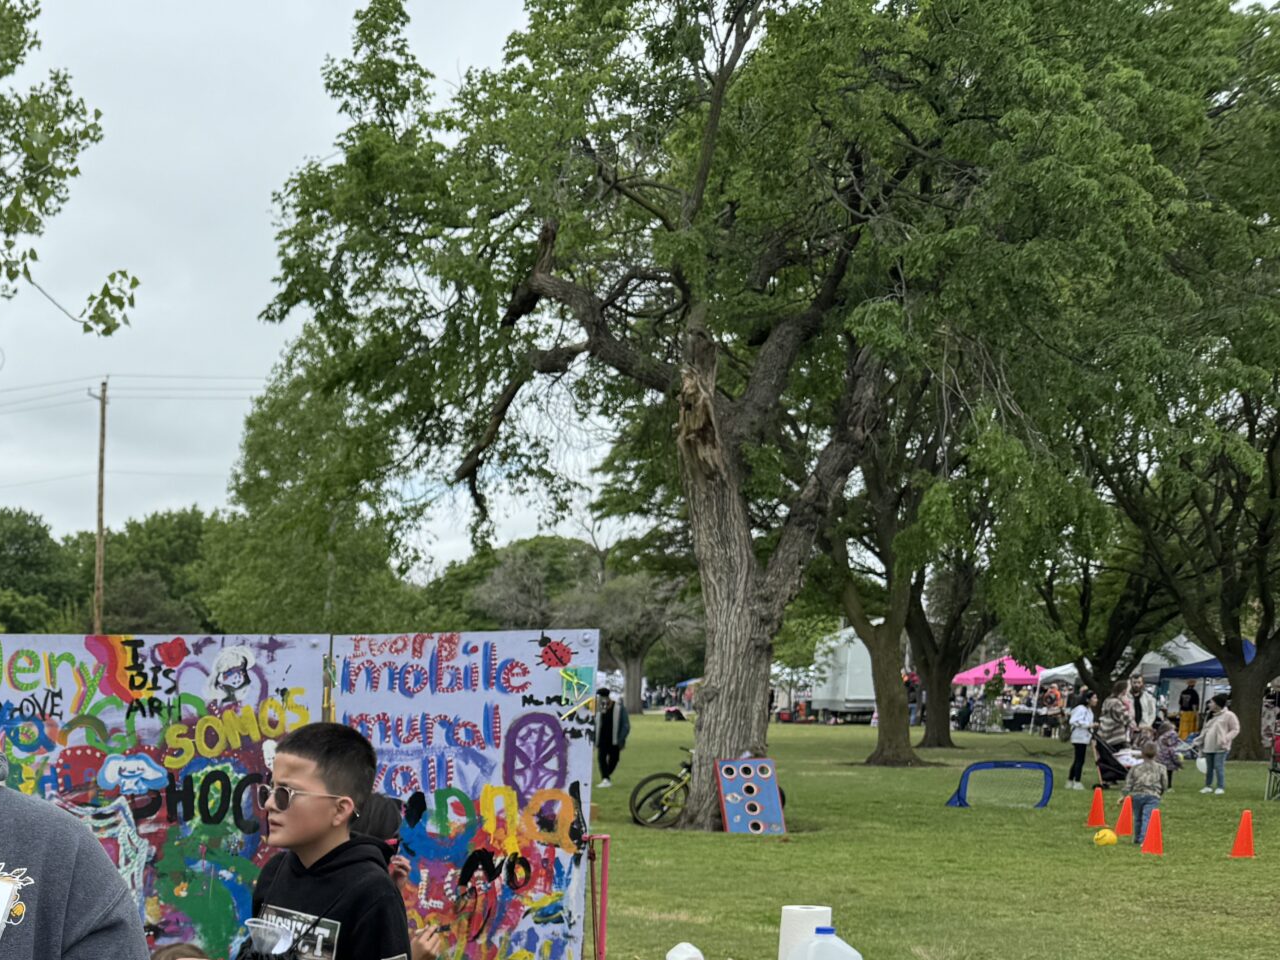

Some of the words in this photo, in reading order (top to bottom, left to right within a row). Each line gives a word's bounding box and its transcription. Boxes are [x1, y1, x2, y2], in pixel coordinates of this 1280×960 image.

[342, 640, 530, 697] mobile
[164, 687, 310, 769] SOMOS
[343, 701, 501, 751] mural
